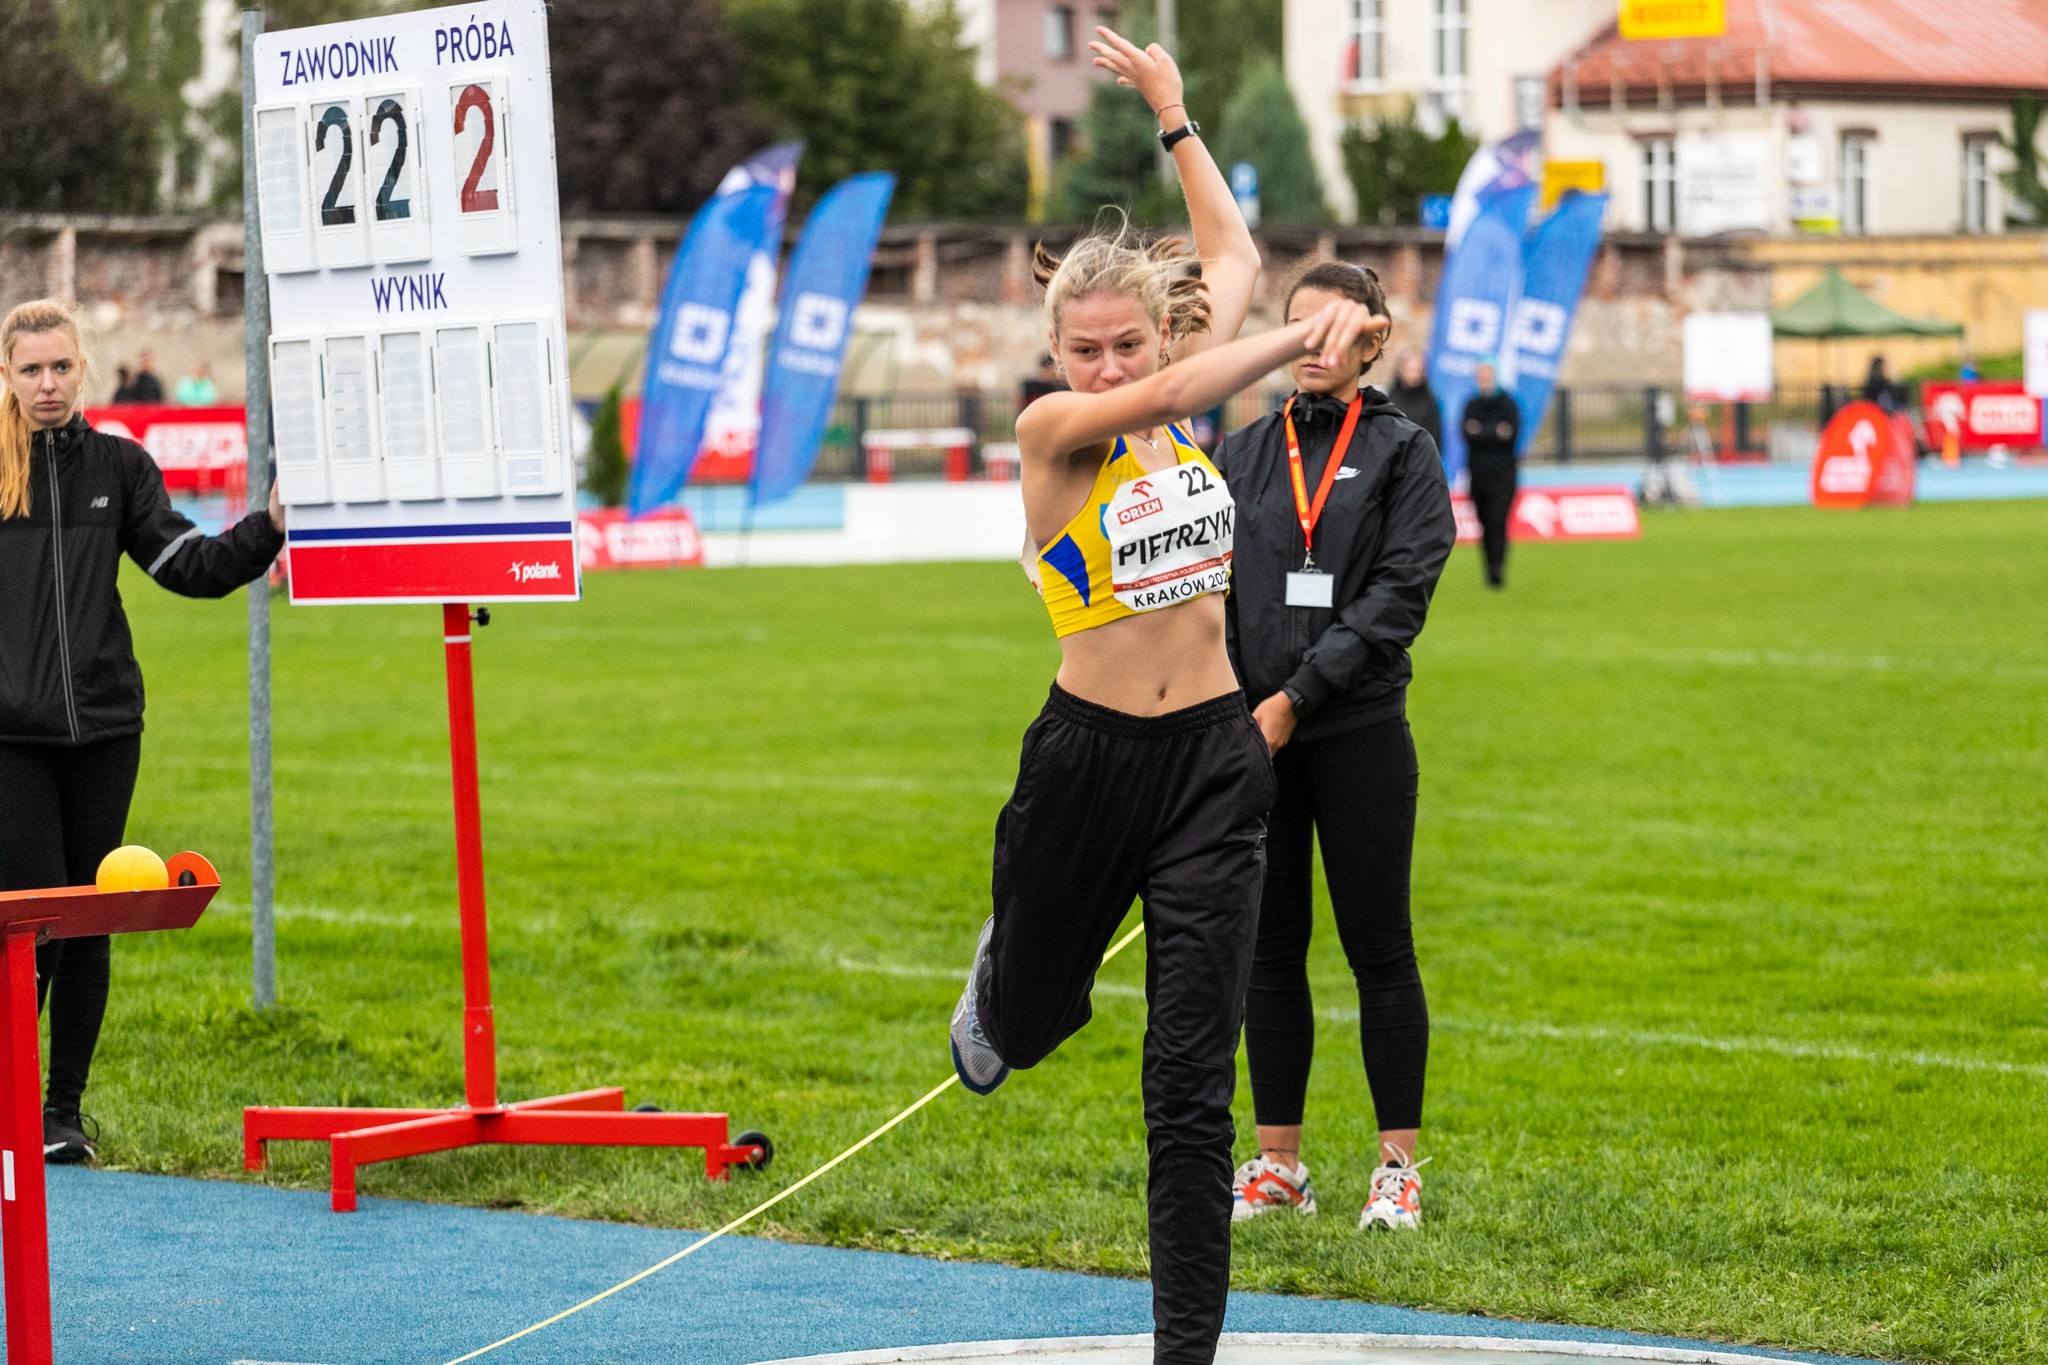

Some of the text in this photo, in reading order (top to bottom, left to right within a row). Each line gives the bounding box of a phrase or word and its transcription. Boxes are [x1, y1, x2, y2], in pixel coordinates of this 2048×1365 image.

[435, 15, 515, 66] PRÓBA
[280, 36, 399, 86] ZAWODNIK
[454, 84, 499, 213] 2
[371, 273, 448, 313] WYNIK
[1178, 466, 1215, 497] 22
[1120, 499, 1161, 522] ORLEN
[1118, 506, 1232, 566] PIETRZYK
[522, 561, 560, 583] polanik
[1134, 570, 1228, 608] KRAKÓW 202
